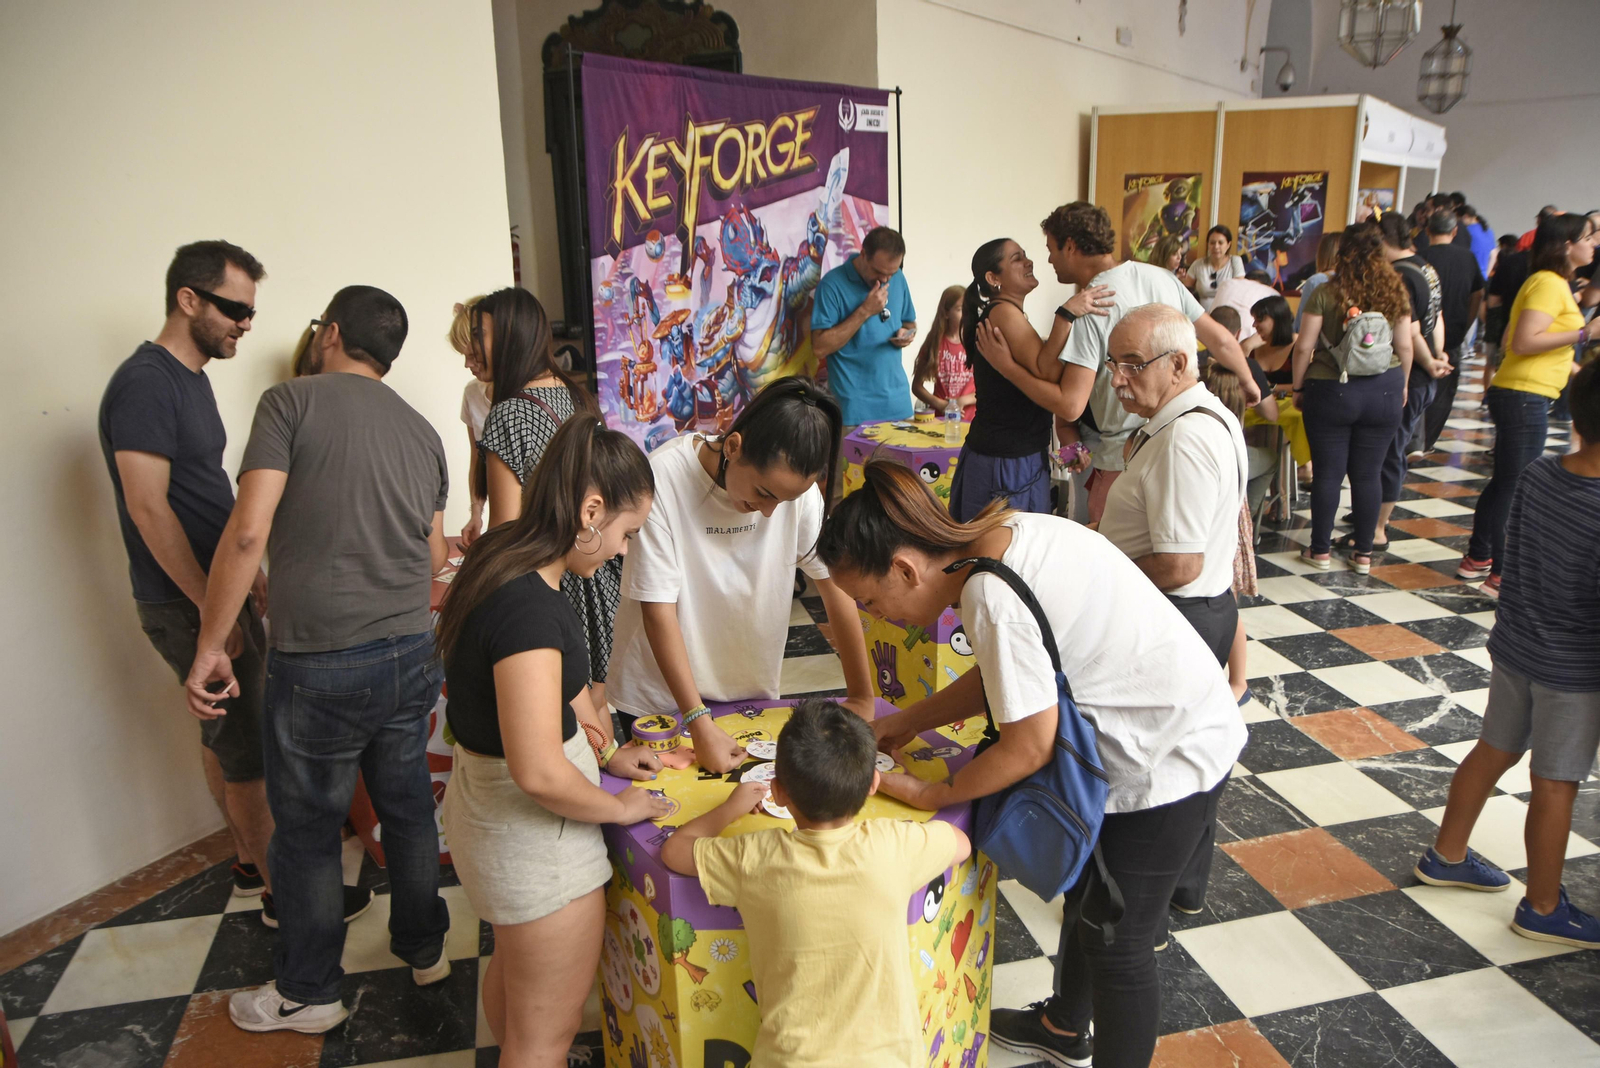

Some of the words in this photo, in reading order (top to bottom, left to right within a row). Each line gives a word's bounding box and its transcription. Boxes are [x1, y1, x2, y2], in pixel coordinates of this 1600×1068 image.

[606, 106, 820, 266] KEYFORGE
[1128, 175, 1164, 193] KEYFORGE
[1281, 173, 1324, 191] KEYFORGE
